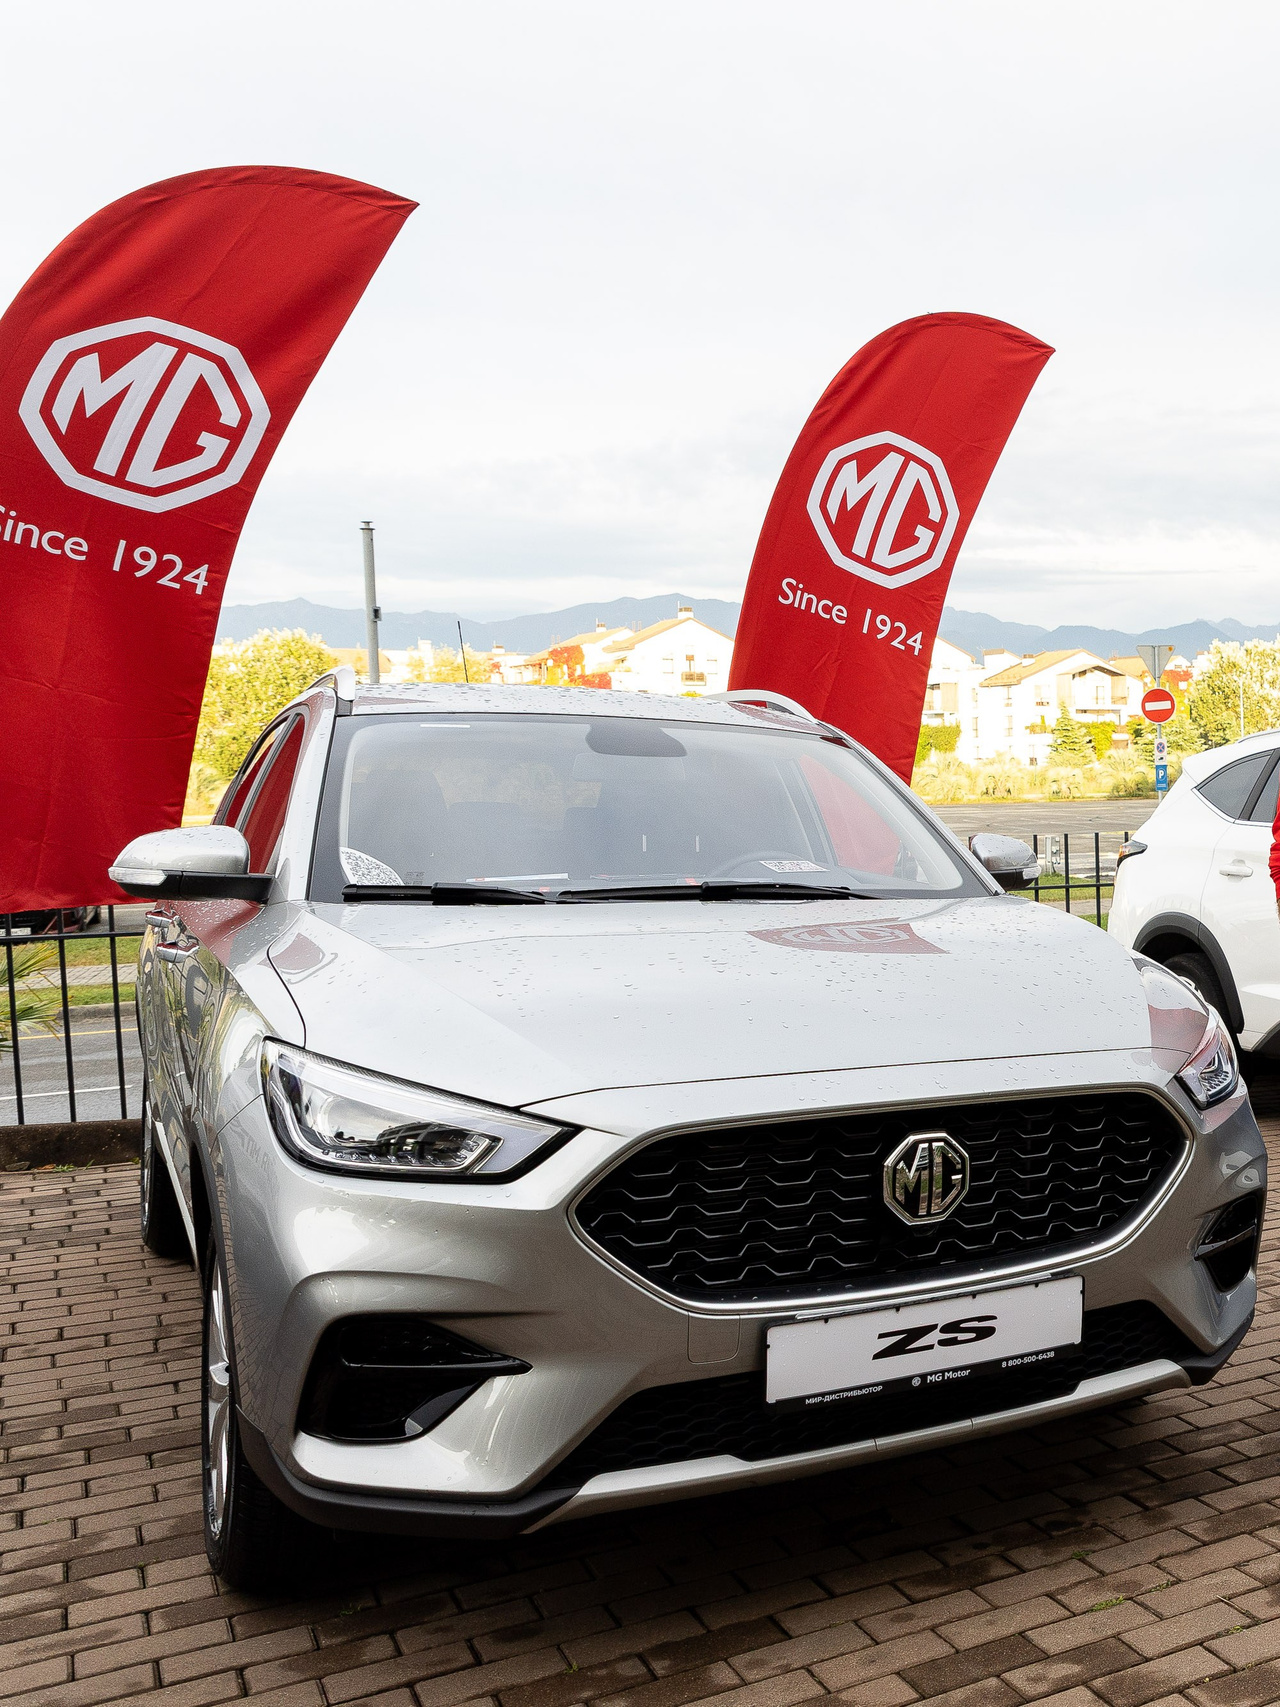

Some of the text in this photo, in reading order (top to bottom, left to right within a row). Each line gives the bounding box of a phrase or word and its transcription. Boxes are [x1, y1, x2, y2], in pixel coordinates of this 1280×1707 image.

[51, 341, 242, 488] MG
[826, 451, 942, 569] MG
[112, 539, 209, 595] 1924
[778, 577, 923, 656] Since 1924
[895, 1141, 963, 1216] MG
[871, 1314, 998, 1361] ZS
[805, 1385, 883, 1405] МИР-ДИСТРИБЬЮТОР
[926, 1373, 943, 1384] MG
[944, 1369, 971, 1381] Motor
